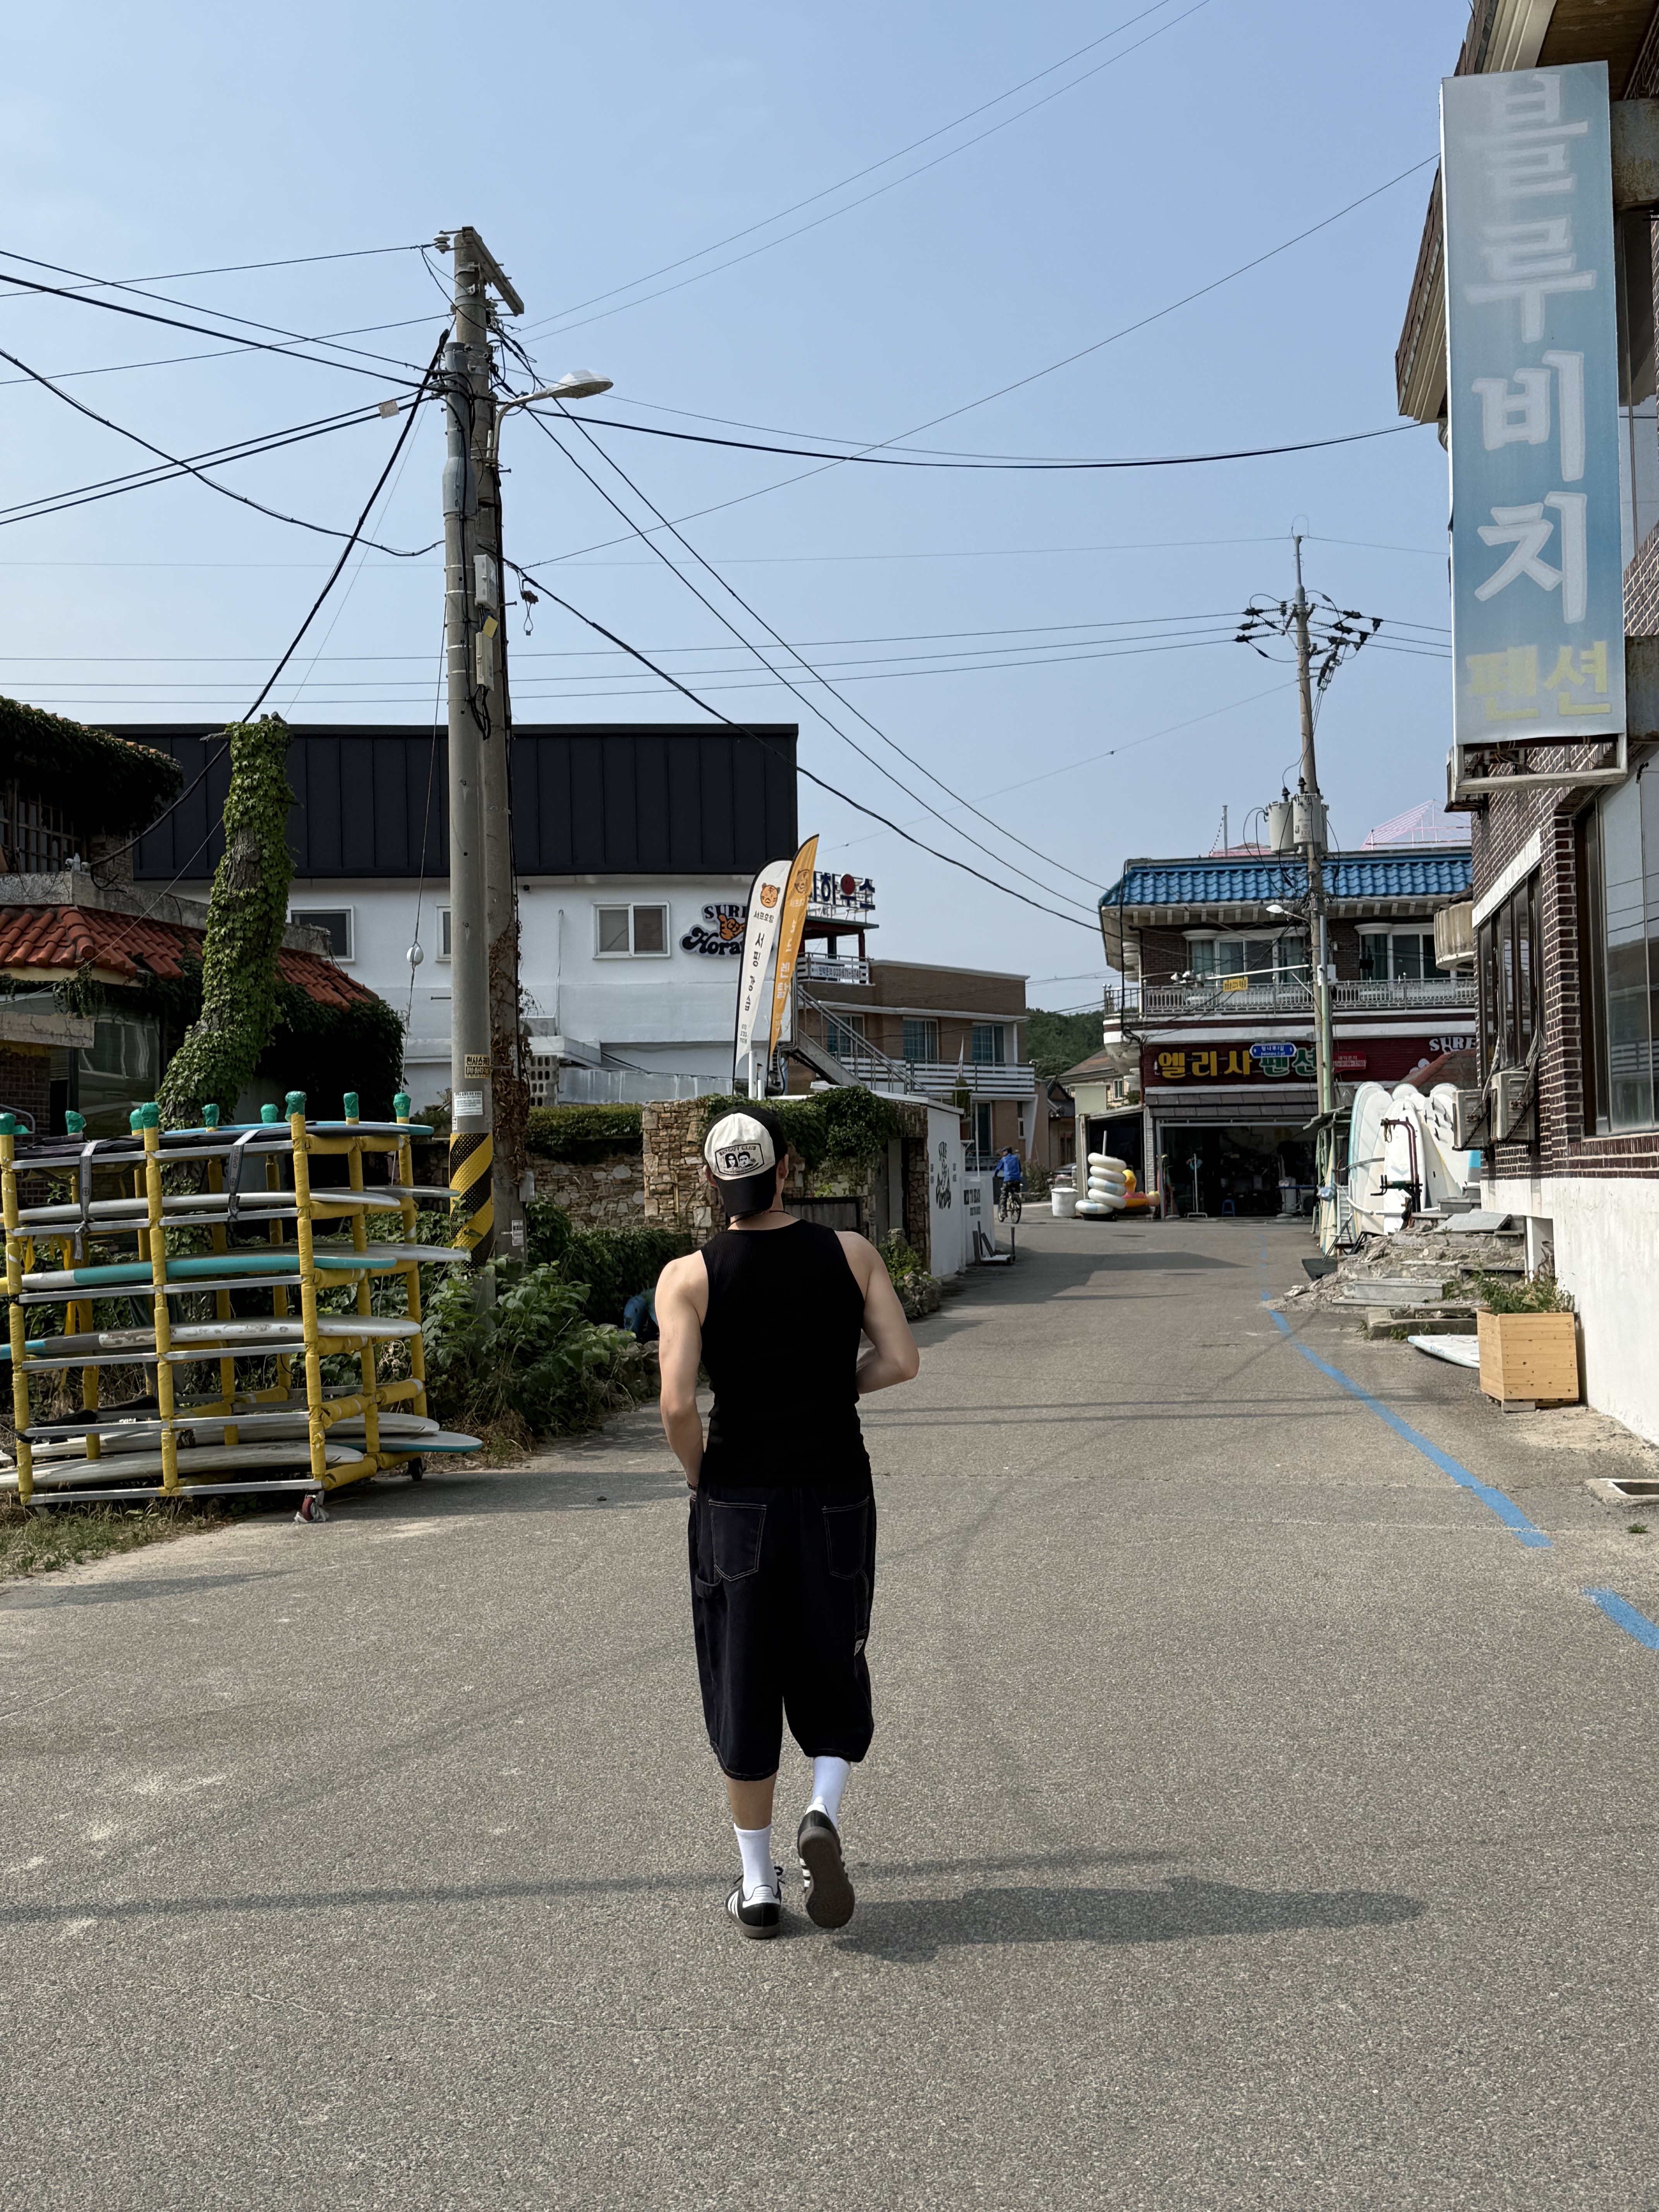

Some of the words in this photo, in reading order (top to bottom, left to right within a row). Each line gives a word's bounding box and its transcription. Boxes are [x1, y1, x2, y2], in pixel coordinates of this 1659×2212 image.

[1462, 73, 1597, 624] 블루비치
[1465, 641, 1611, 721] 펜션
[813, 871, 876, 910] 하우스
[682, 927, 742, 955] Hora
[752, 932, 765, 967] 서핑
[1158, 1050, 1252, 1079] 엘리사
